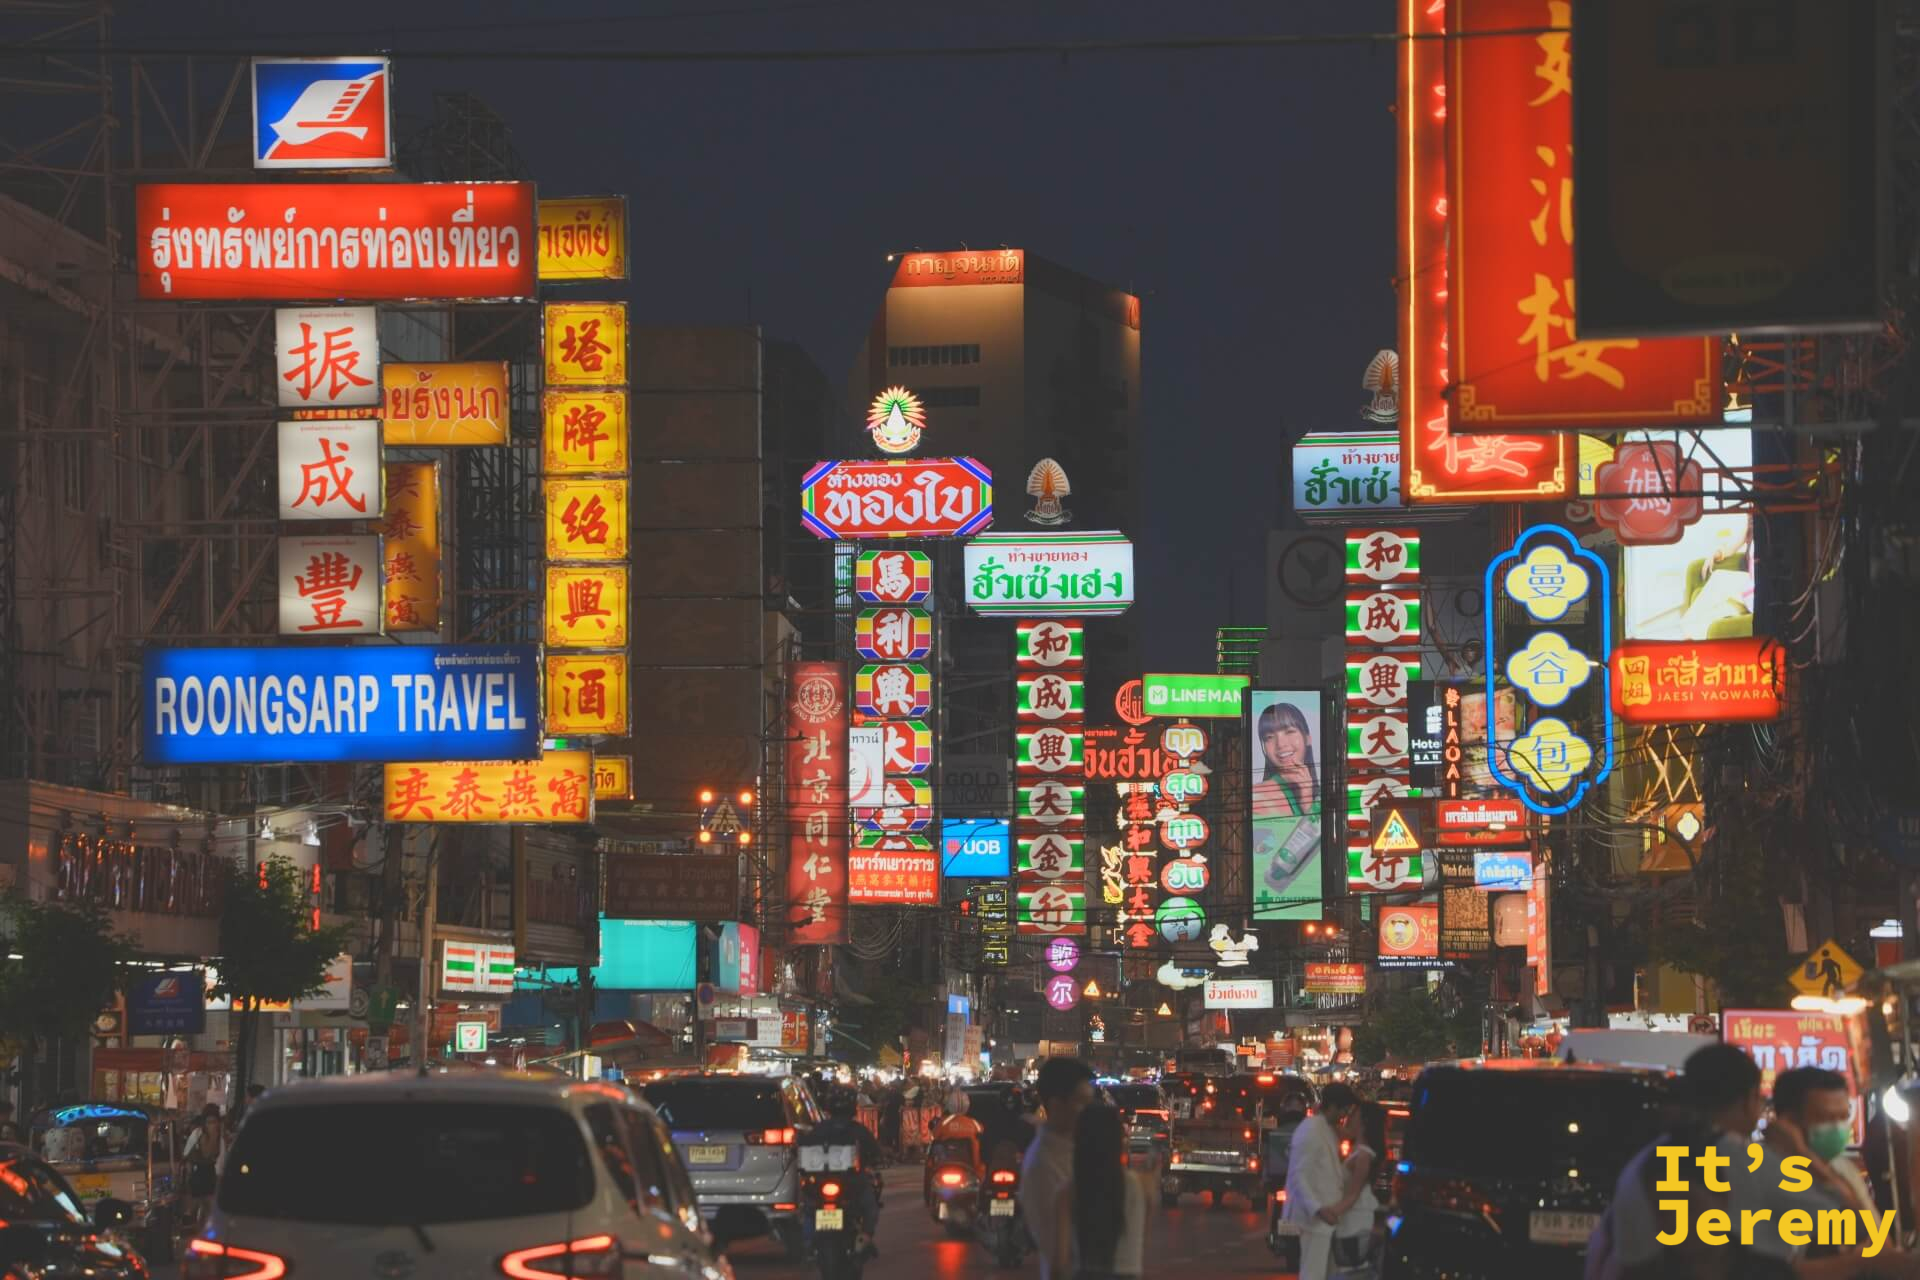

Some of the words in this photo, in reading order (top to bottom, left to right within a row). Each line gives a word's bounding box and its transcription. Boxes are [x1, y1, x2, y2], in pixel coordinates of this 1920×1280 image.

[151, 191, 520, 294] รุ่งทรัพย์การท่องเที่ยว
[537, 209, 611, 258] าเจดีย์
[823, 471, 974, 526] ทองใบ
[827, 468, 903, 488] ห้างทอง
[972, 556, 1123, 599] ฮั่วเซ่งเฮง
[1527, 563, 1573, 771] 曼谷包
[1703, 662, 1759, 687] สาขา
[155, 674, 380, 737] ROONGSARP
[391, 672, 527, 733] TRAVEL
[1657, 690, 1694, 703] JAESI
[963, 839, 1000, 854] UOB
